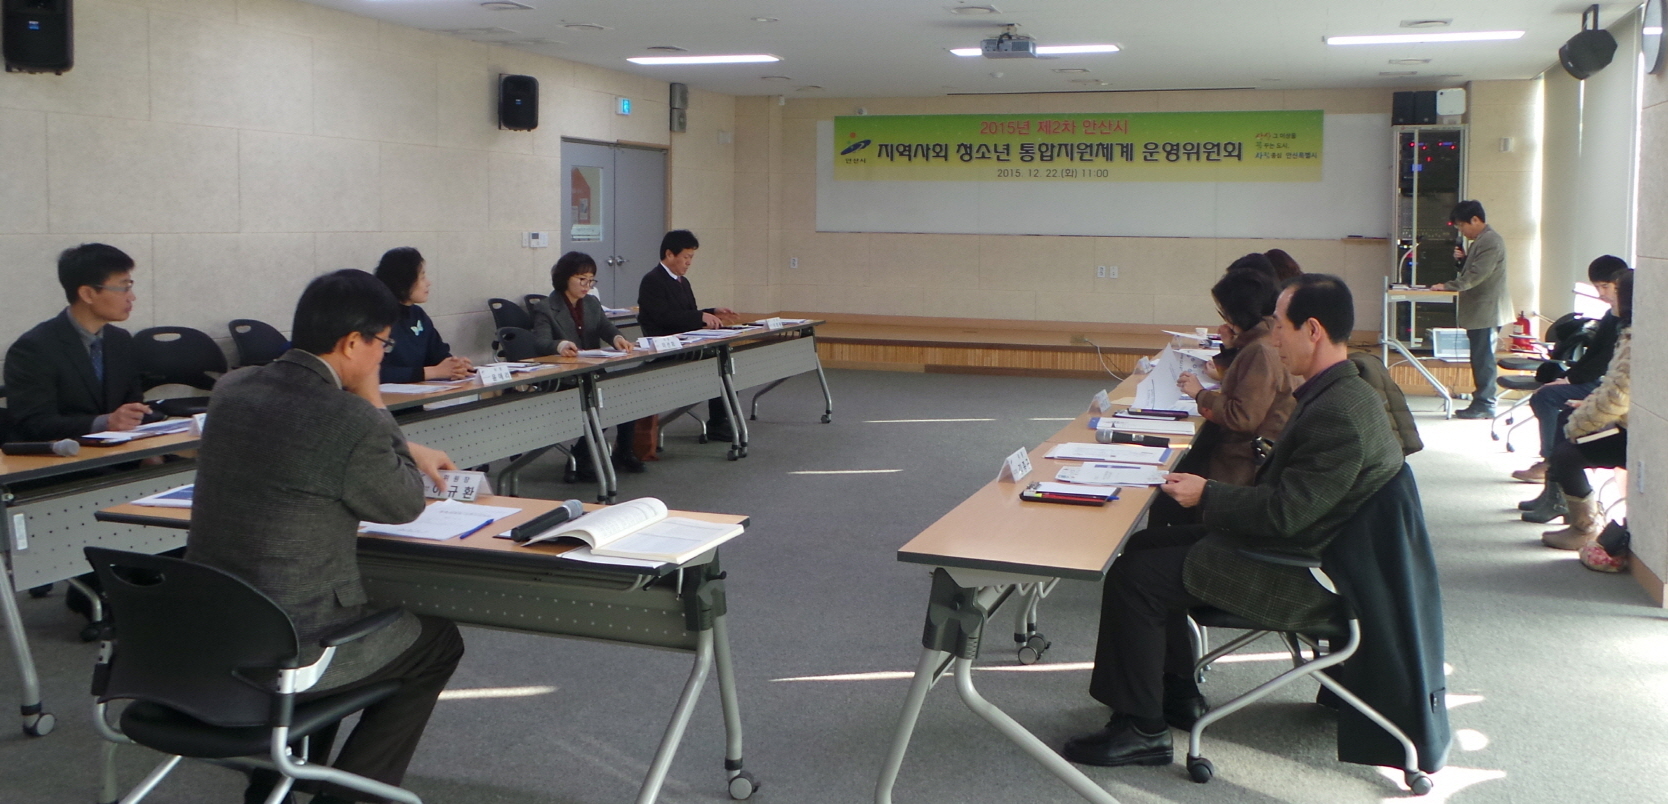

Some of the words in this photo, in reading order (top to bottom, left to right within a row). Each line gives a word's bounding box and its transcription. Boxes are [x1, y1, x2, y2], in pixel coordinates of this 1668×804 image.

[980, 120, 1030, 135] 2015년
[1037, 119, 1076, 135] 제2차
[1083, 119, 1128, 135] 안산시
[877, 142, 948, 162] 지역사회
[956, 142, 1010, 162] 청소년
[1019, 141, 1134, 162] 통합지원체계
[1142, 141, 1242, 162] 운영위원회
[997, 168, 1024, 178] 2015.
[1028, 168, 1042, 178] 12.
[1046, 168, 1078, 179] 22.(화)
[1082, 168, 1109, 178] 11:00
